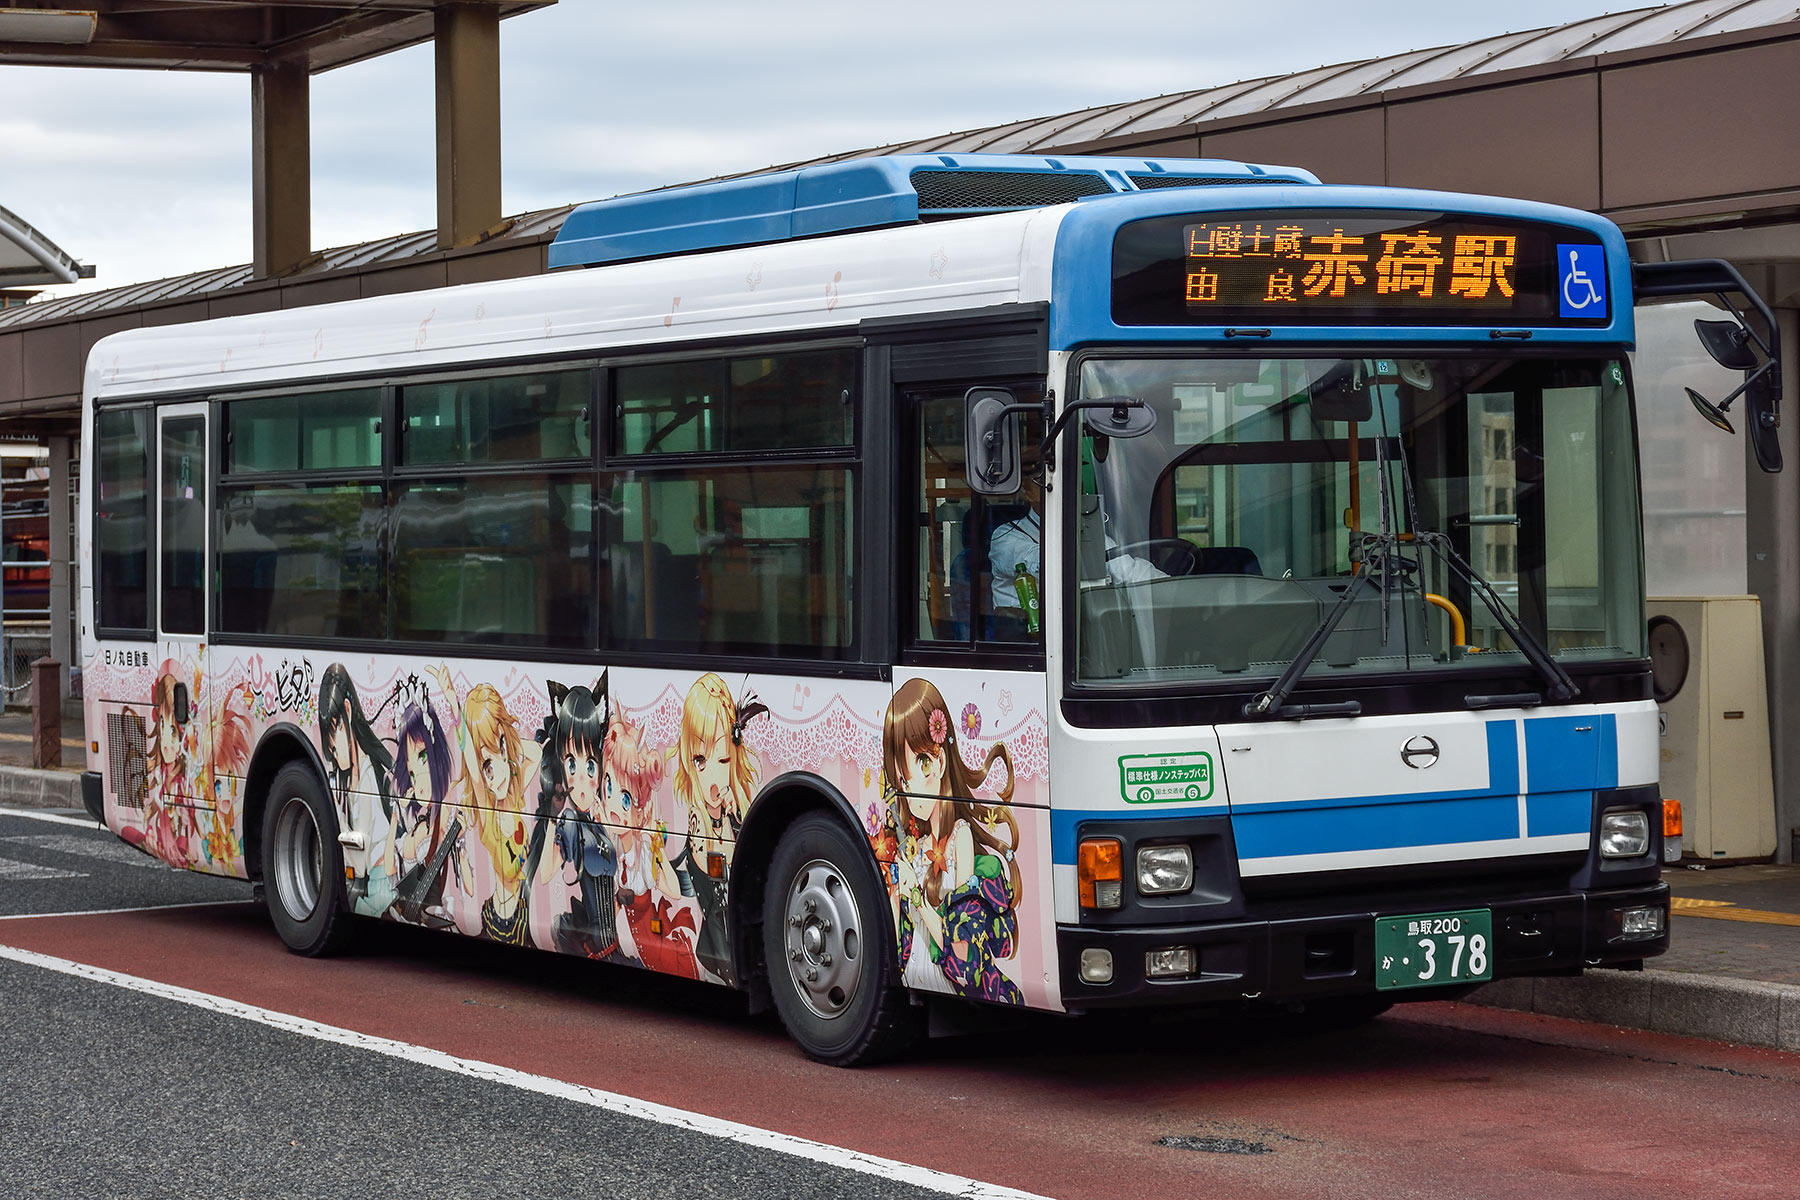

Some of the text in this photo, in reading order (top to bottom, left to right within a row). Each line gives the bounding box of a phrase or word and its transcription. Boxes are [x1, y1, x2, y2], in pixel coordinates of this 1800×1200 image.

[1190, 223, 1304, 258] 白壁土蔵
[105, 649, 149, 667] 日ノ丸自動車
